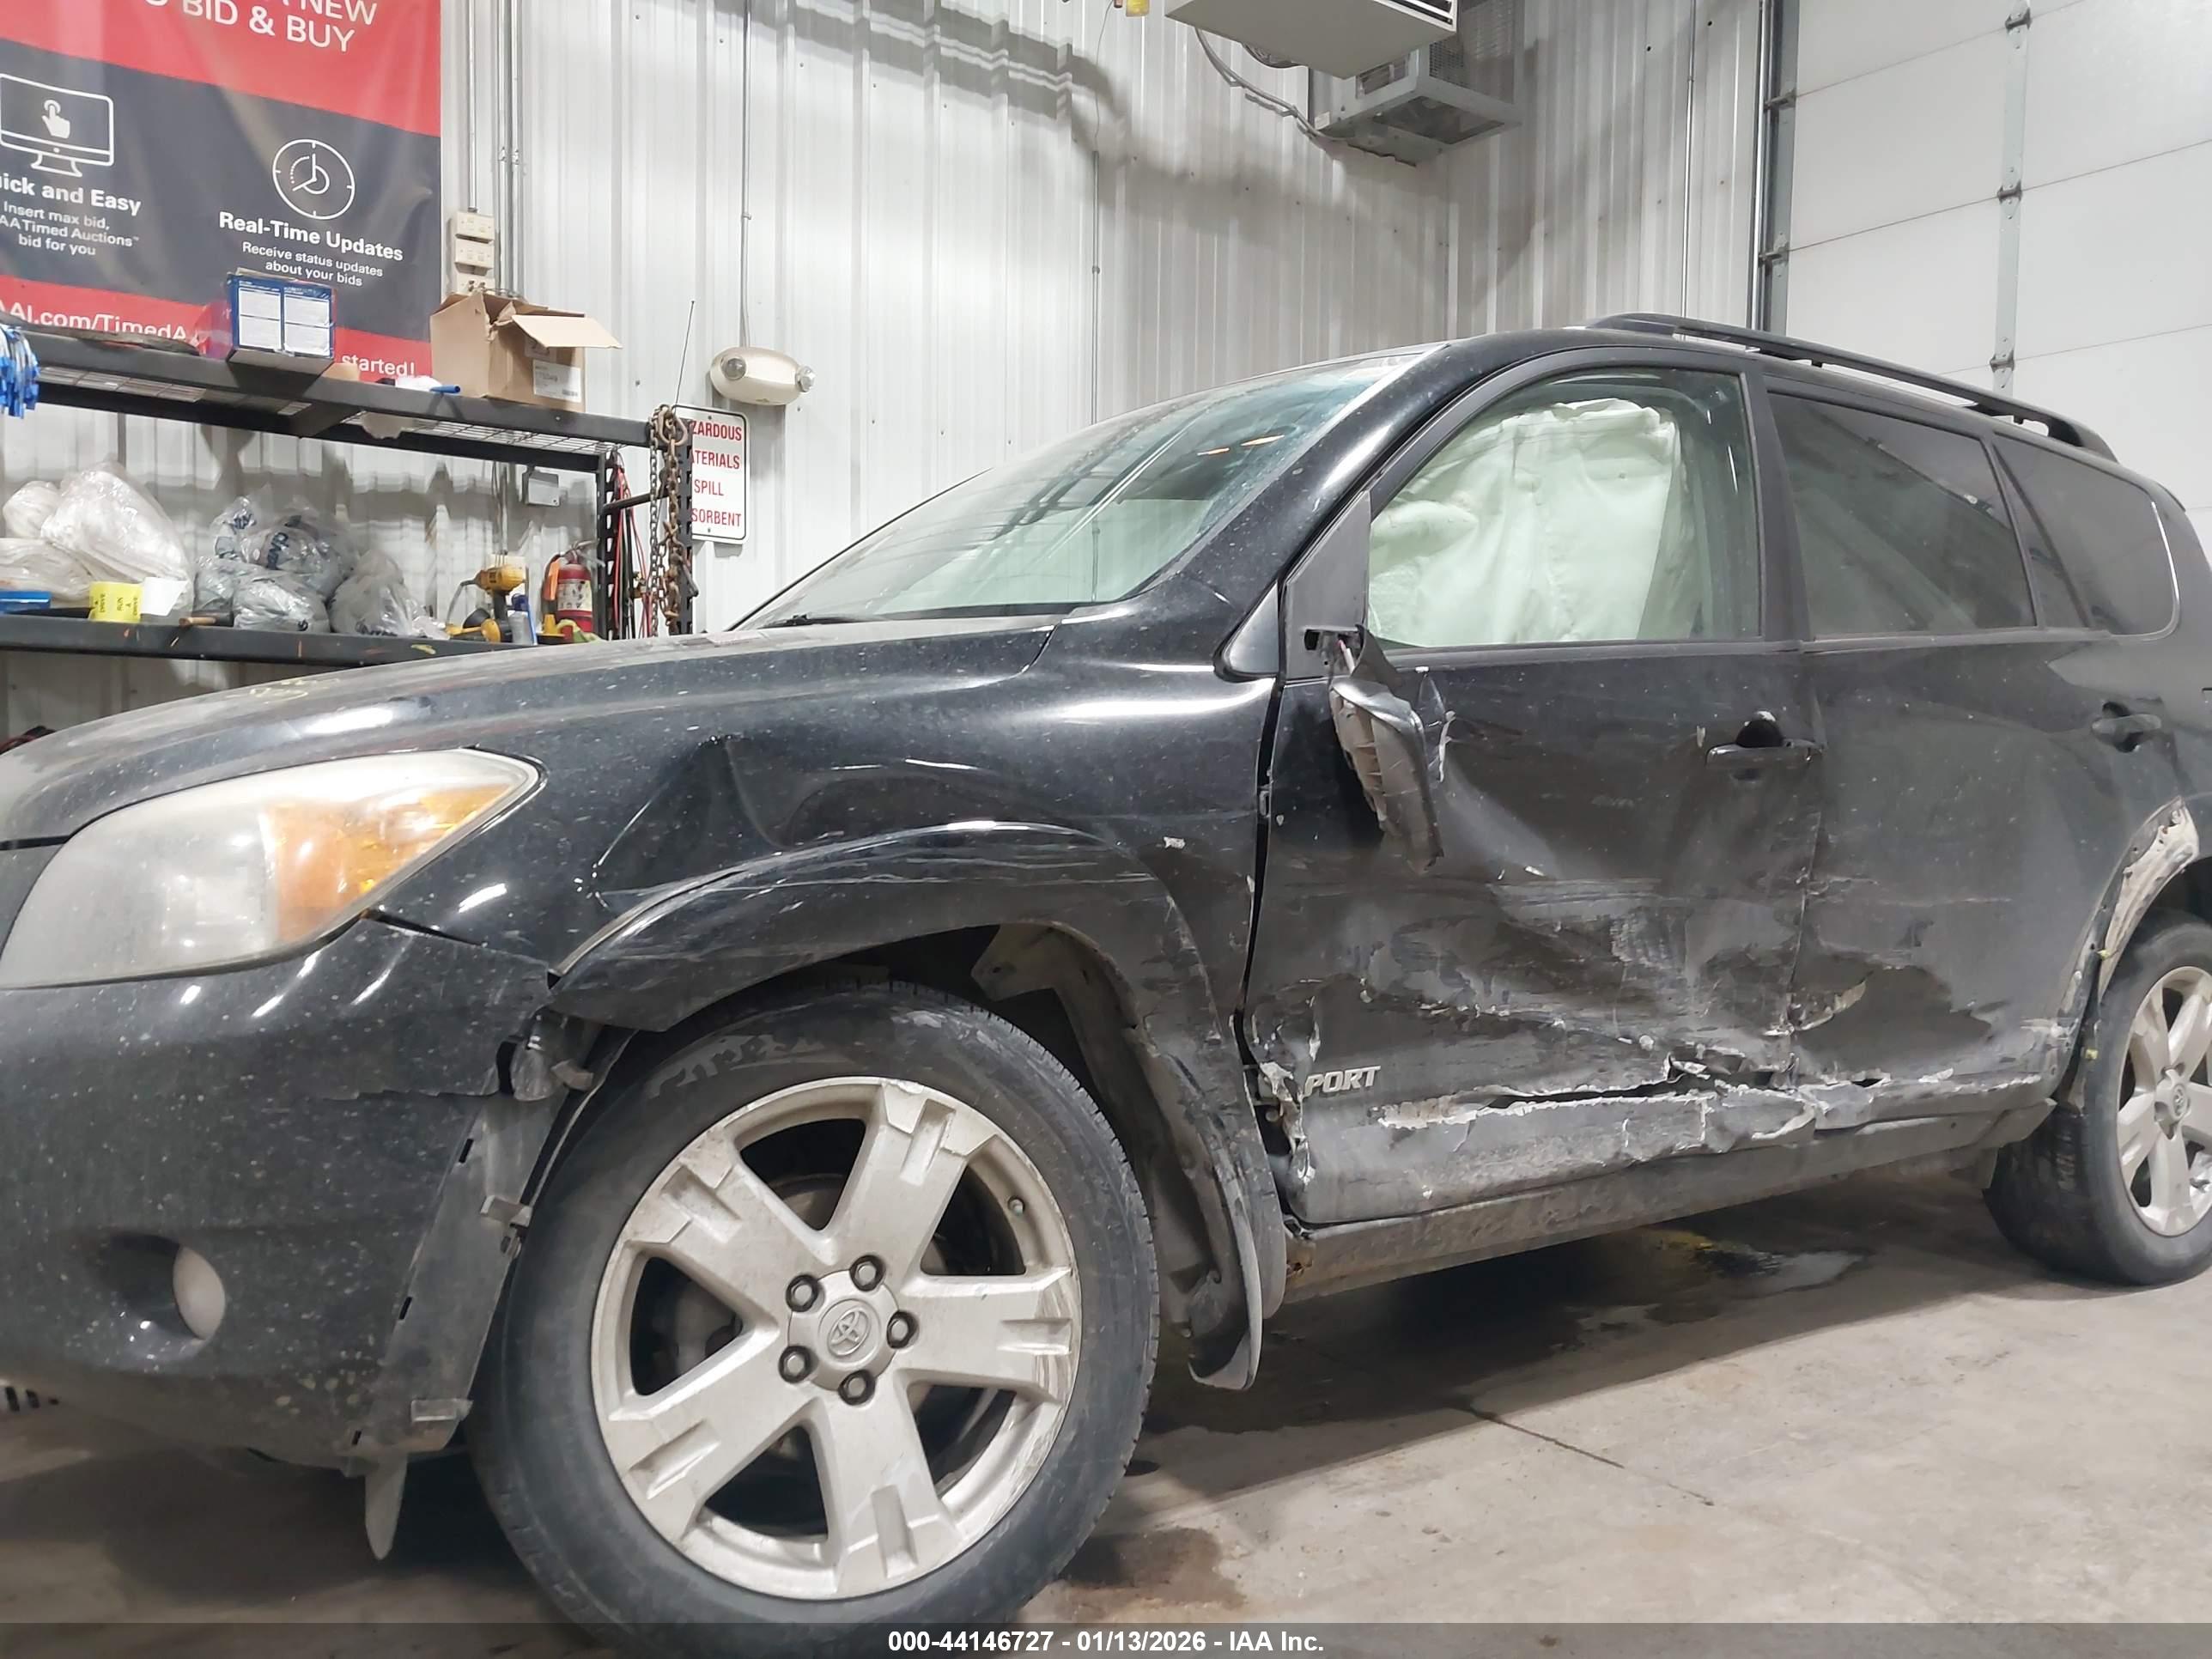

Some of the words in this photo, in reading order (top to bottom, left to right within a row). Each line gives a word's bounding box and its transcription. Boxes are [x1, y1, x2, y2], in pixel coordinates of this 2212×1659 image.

[183, 0, 238, 25] BID
[249, 6, 275, 36] &
[286, 15, 355, 52] BUY
[0, 173, 35, 196] ick
[41, 185, 83, 204] and
[90, 188, 141, 216] Easy
[4, 200, 45, 220] Insert
[49, 211, 80, 225] max
[83, 216, 110, 230] bid,
[19, 234, 41, 248] bid
[46, 238, 66, 251] for
[70, 243, 96, 255] you
[219, 211, 320, 245] Real-Time
[326, 230, 404, 261] Updates
[242, 241, 293, 260] Receive
[295, 252, 333, 268] status
[336, 259, 383, 276] updates
[265, 260, 303, 276] about
[306, 267, 333, 282] your
[337, 272, 362, 286] bids
[694, 478, 725, 496] SPILL
